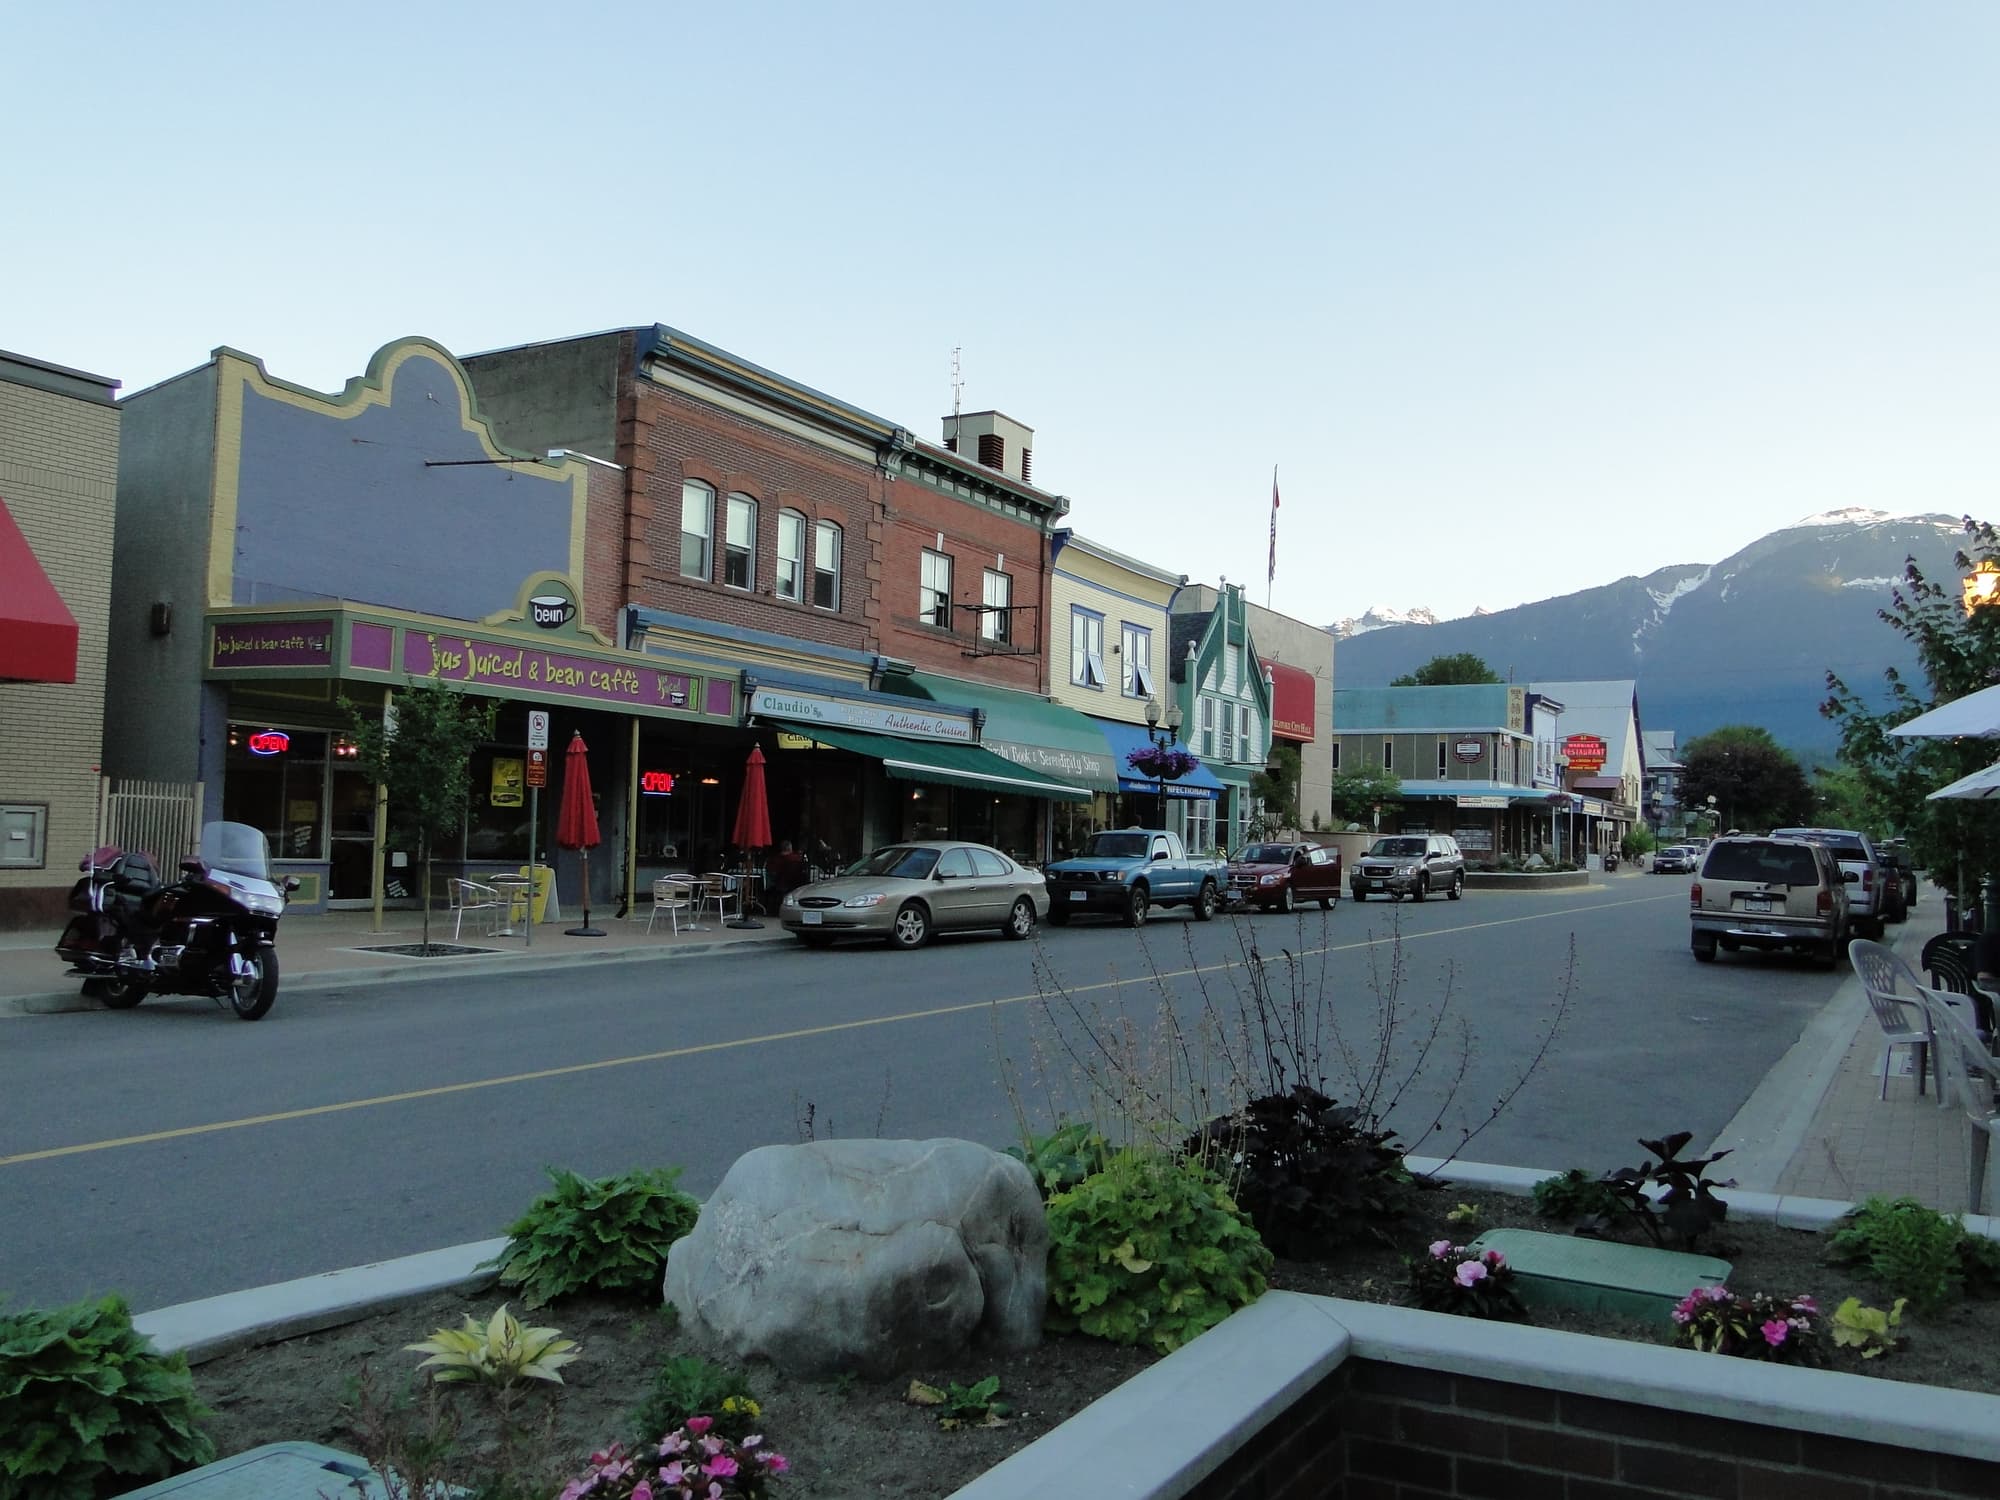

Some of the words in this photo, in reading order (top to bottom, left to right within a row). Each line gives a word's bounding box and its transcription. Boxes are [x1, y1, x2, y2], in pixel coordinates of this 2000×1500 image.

[261, 635, 278, 650] bean
[427, 634, 461, 677] jus
[463, 640, 522, 681] juiced
[528, 660, 539, 682] &
[545, 655, 585, 688] bean
[762, 697, 819, 716] Claudio's
[884, 713, 932, 733] Authentic
[934, 720, 968, 738] Cuisine
[249, 735, 289, 752] OPEN
[1562, 748, 1605, 756] RESTAURANT
[1038, 749, 1082, 775] Serendipity
[1082, 754, 1101, 777] Shop
[644, 773, 672, 792] OPEN
